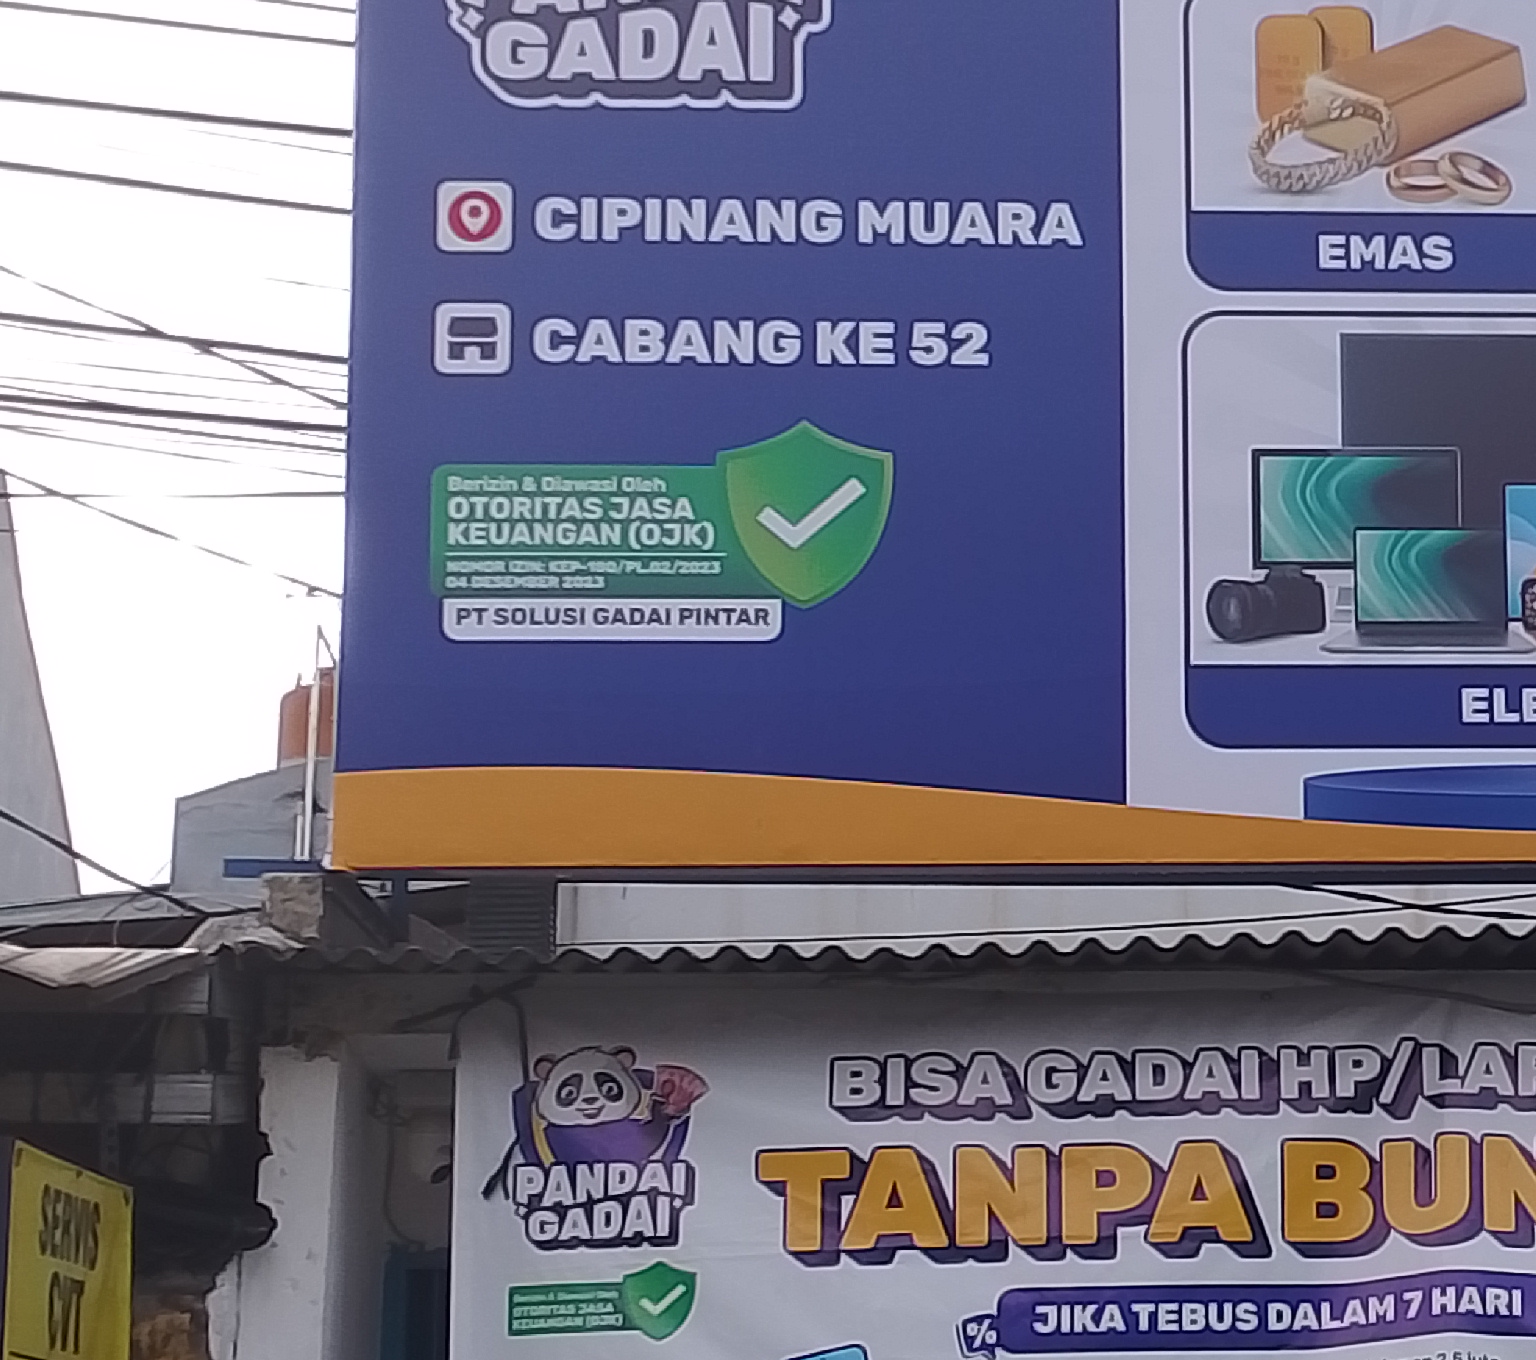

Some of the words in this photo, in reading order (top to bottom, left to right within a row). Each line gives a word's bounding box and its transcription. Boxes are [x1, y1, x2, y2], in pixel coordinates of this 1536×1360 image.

[484, 0, 775, 82] GADAI
[534, 196, 843, 244] CIPINANG
[857, 200, 1085, 247] MUARA
[1317, 234, 1454, 272] EMAS
[532, 319, 803, 366] CABANG
[814, 321, 898, 366] KE
[907, 321, 990, 367] 52
[447, 497, 603, 520] OTORITAS
[607, 497, 695, 520] JASA
[447, 523, 621, 547] KEUANGAN
[627, 521, 715, 550] (OJK)
[455, 607, 488, 626] PT
[492, 607, 585, 626] SOLUSI
[592, 607, 671, 626] GADAI
[678, 608, 769, 627] PINTAR
[829, 1051, 1018, 1110] BISA
[1025, 1048, 1264, 1106] GADAI
[515, 1161, 687, 1207] PANDAI
[756, 1139, 1255, 1252] TANPA
[38, 1183, 100, 1271] SERVIS
[527, 1195, 671, 1241] GADAI
[1032, 1304, 1126, 1334] JIKA
[1131, 1302, 1259, 1332] TEBUS
[1268, 1296, 1395, 1331] DALAM
[1402, 1291, 1423, 1319] 7
[1431, 1287, 1523, 1318] HARI
